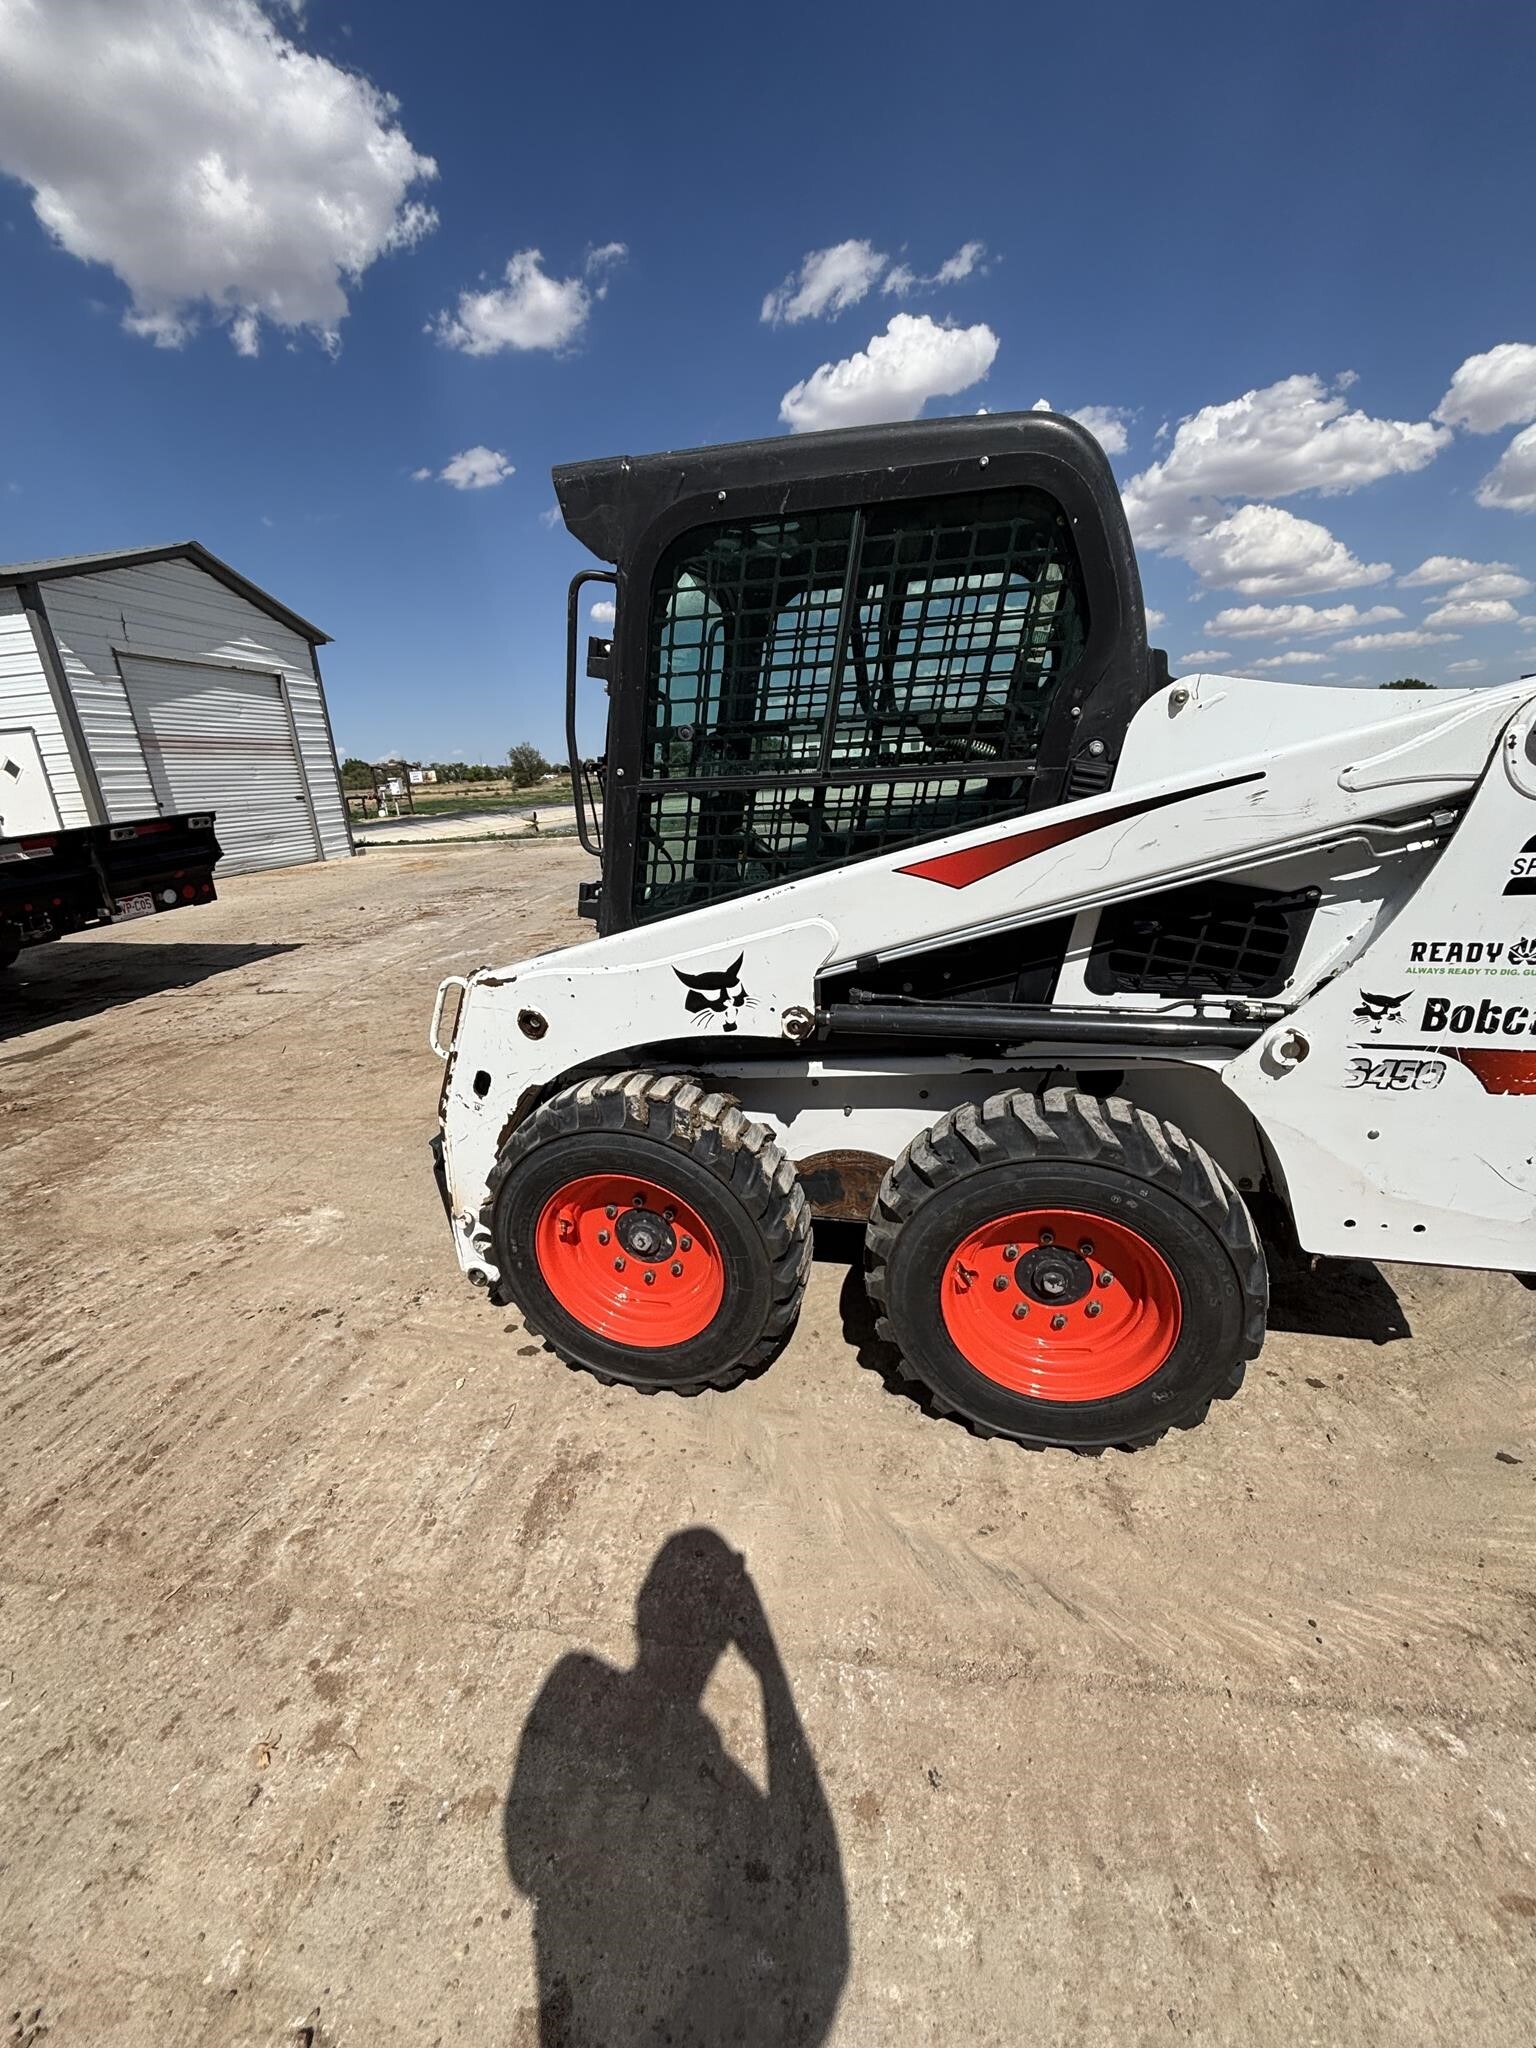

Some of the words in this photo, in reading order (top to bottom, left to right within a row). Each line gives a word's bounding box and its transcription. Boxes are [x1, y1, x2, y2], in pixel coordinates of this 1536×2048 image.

[1410, 941, 1504, 963] READY
[1405, 967, 1445, 975] ALWAYS
[1448, 968, 1481, 976] READY
[1484, 968, 1498, 976] TO
[1342, 1057, 1447, 1091] S450
